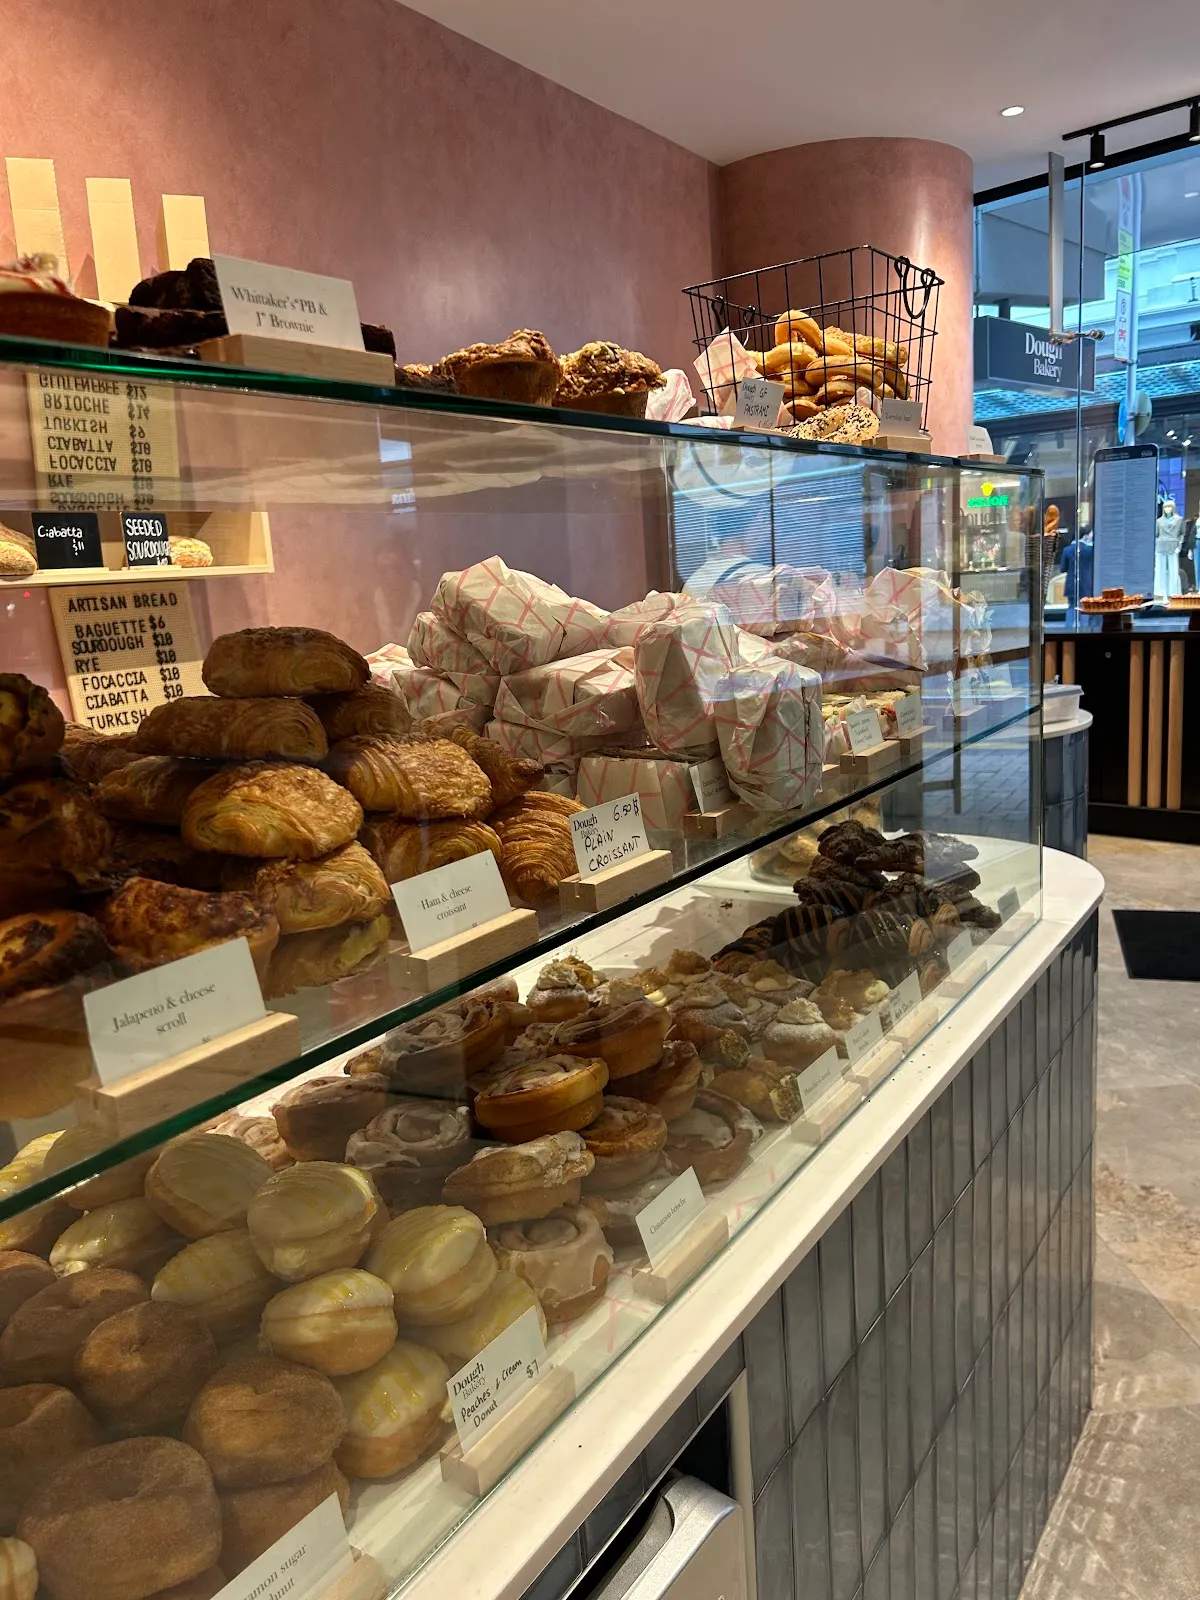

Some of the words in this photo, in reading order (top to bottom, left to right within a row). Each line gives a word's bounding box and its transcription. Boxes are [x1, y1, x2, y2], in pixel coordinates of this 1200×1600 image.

[318, 303, 328, 316] &
[268, 313, 315, 334] Brownie
[1033, 358, 1063, 383] Bakery
[37, 525, 83, 539] Ciabatta
[125, 518, 163, 537] SEEDED
[72, 538, 85, 556] $11
[68, 595, 127, 613] ARTISAN
[133, 592, 178, 609] BREAD
[74, 619, 147, 639] BAGUETTE
[148, 615, 166, 631] $6
[71, 635, 144, 656] SOURDOUGH
[152, 632, 174, 648] $10
[74, 657, 101, 674] RYE
[155, 650, 177, 665] $10
[81, 671, 148, 692] FOCACCIA
[159, 667, 181, 683] $10
[85, 688, 150, 711] CIABATTA
[163, 684, 184, 700] $10
[87, 709, 149, 730] TURKISH
[573, 813, 598, 832] Dough
[420, 897, 441, 911] Ham
[440, 894, 448, 904] &
[449, 885, 473, 900] cheese
[436, 902, 467, 921] croissant
[165, 996, 178, 1011] &
[179, 983, 217, 1005] cheese
[156, 1012, 188, 1035] scroll
[452, 1361, 486, 1397] Dough
[526, 1358, 540, 1379] $7
[462, 1376, 487, 1400] Bakery
[460, 1387, 492, 1423] Peaches
[473, 1399, 499, 1428] Donut
[280, 1544, 308, 1574] sugar
